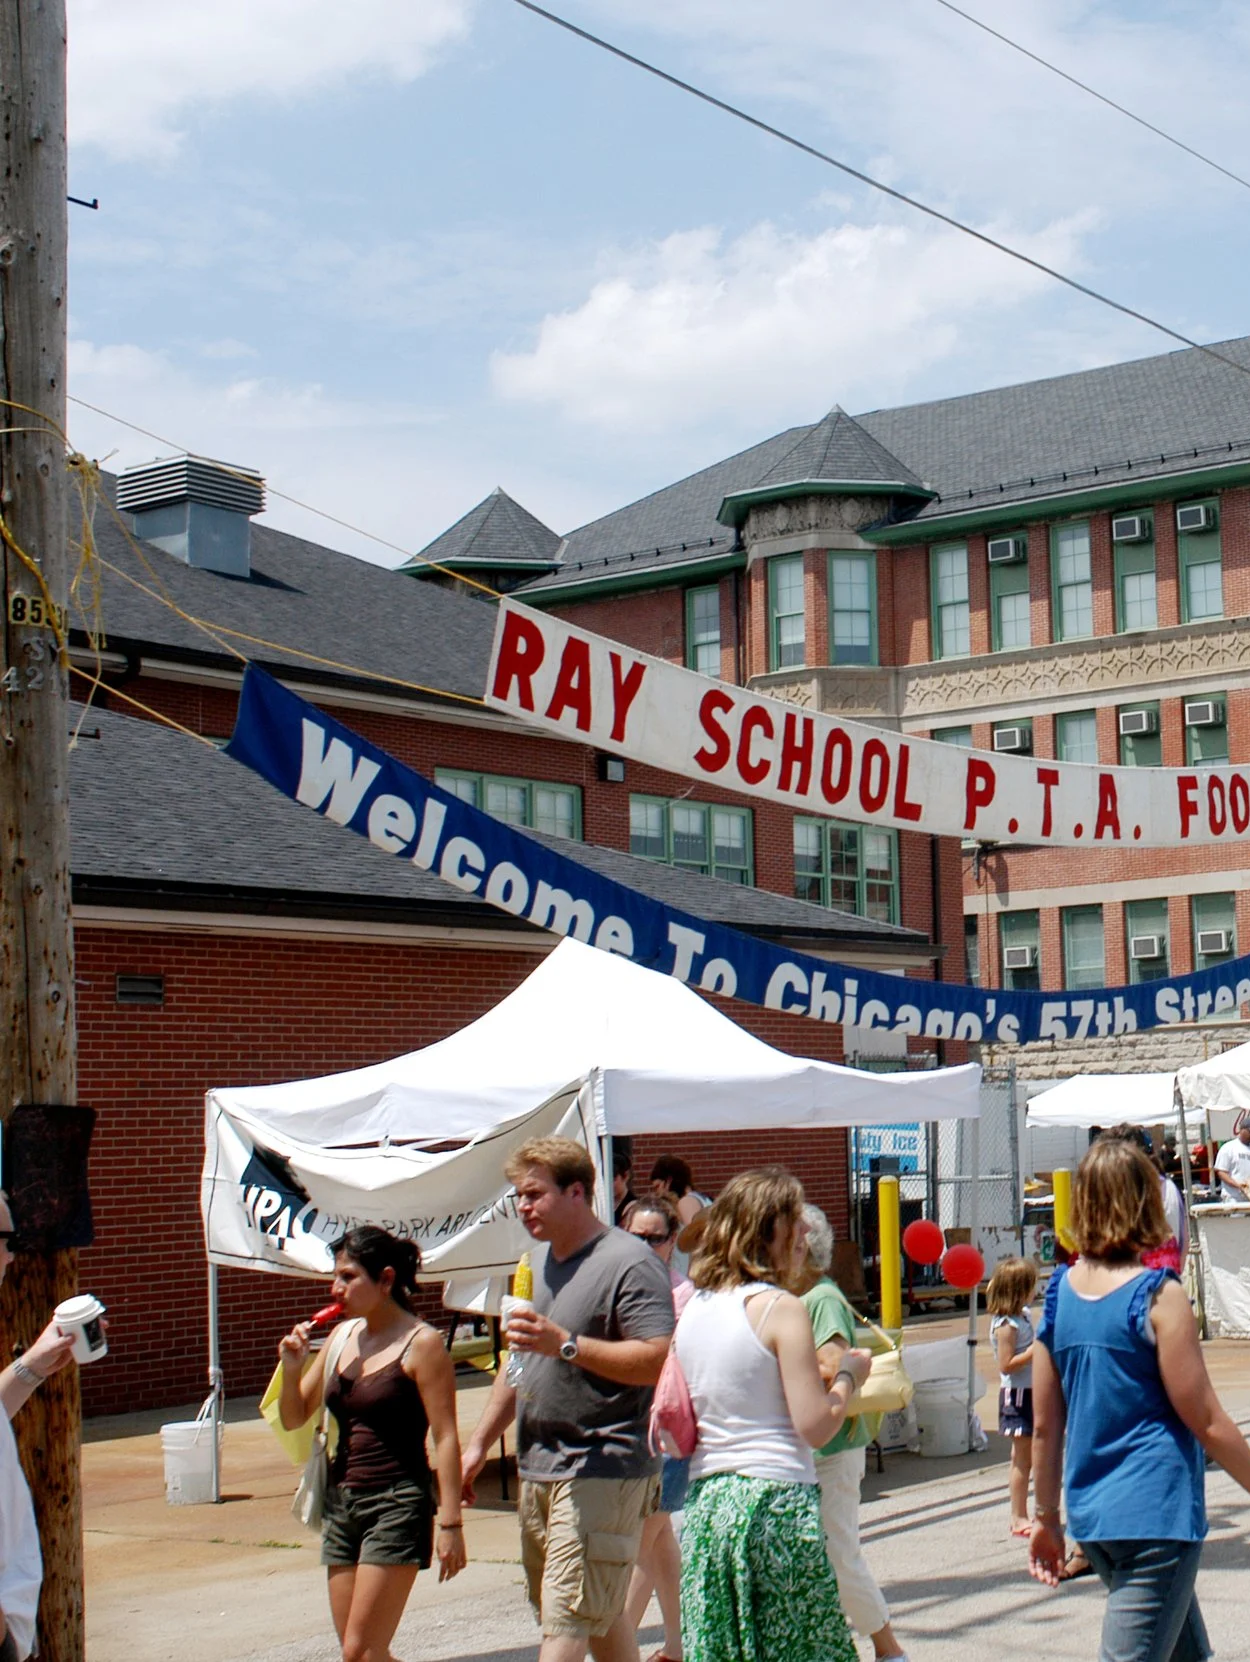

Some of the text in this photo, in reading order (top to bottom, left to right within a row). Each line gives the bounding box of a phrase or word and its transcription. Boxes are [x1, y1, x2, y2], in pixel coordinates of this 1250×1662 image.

[492, 610, 646, 743] RAY
[693, 690, 922, 822] SCHOOL
[297, 718, 634, 959] Welcome
[667, 922, 737, 998] To
[764, 962, 1020, 1043] Chicago's
[1039, 995, 1137, 1040] 57th
